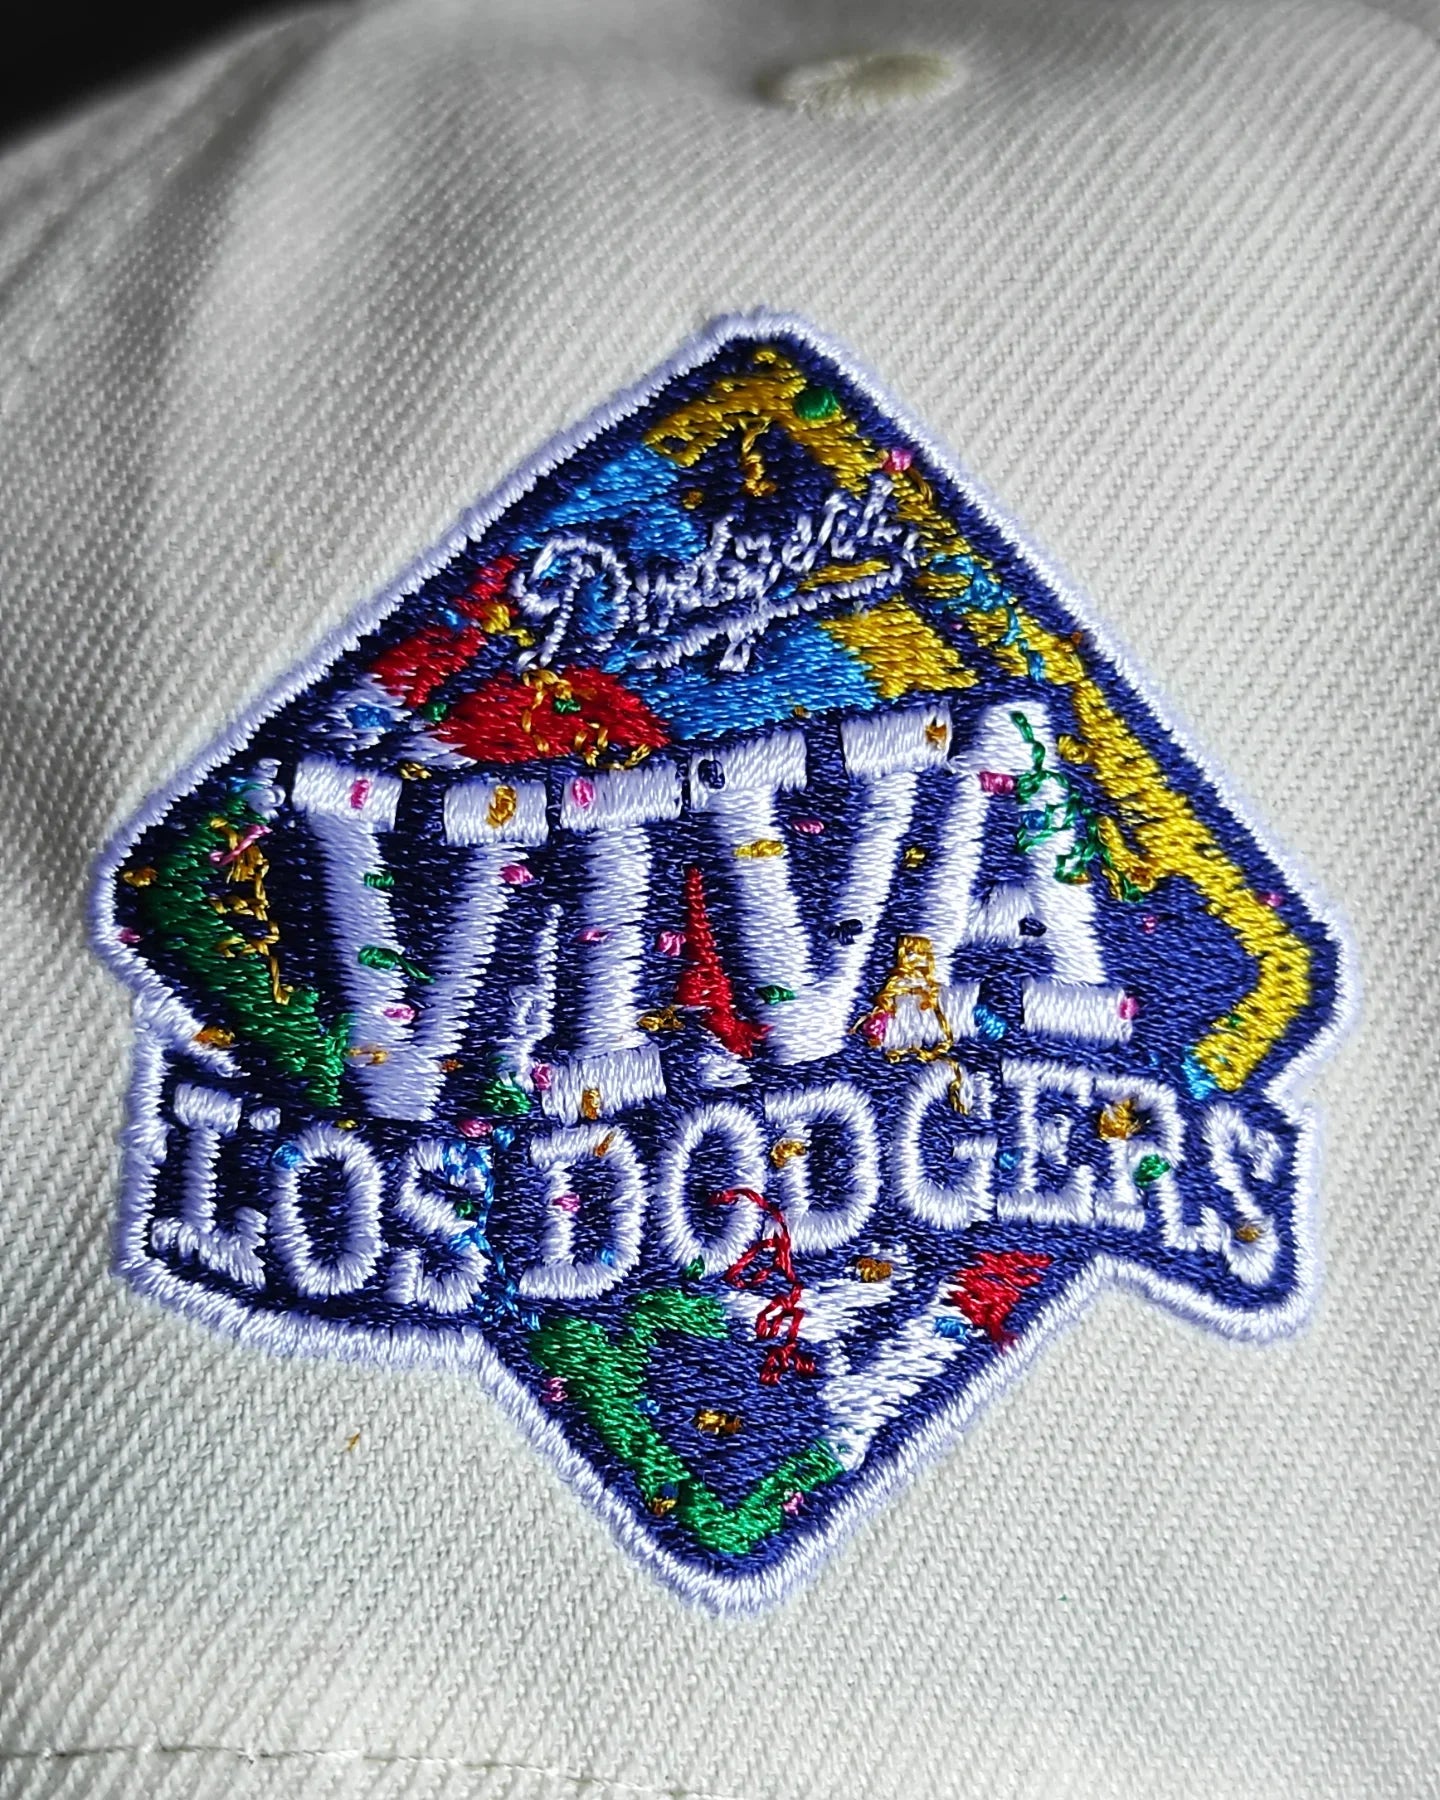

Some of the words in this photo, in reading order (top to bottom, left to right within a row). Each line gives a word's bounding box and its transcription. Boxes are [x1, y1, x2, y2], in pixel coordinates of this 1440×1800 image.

[291, 701, 1132, 1121] VIVA
[151, 1084, 490, 1314] LOS
[518, 1059, 1284, 1299] DODGERS
